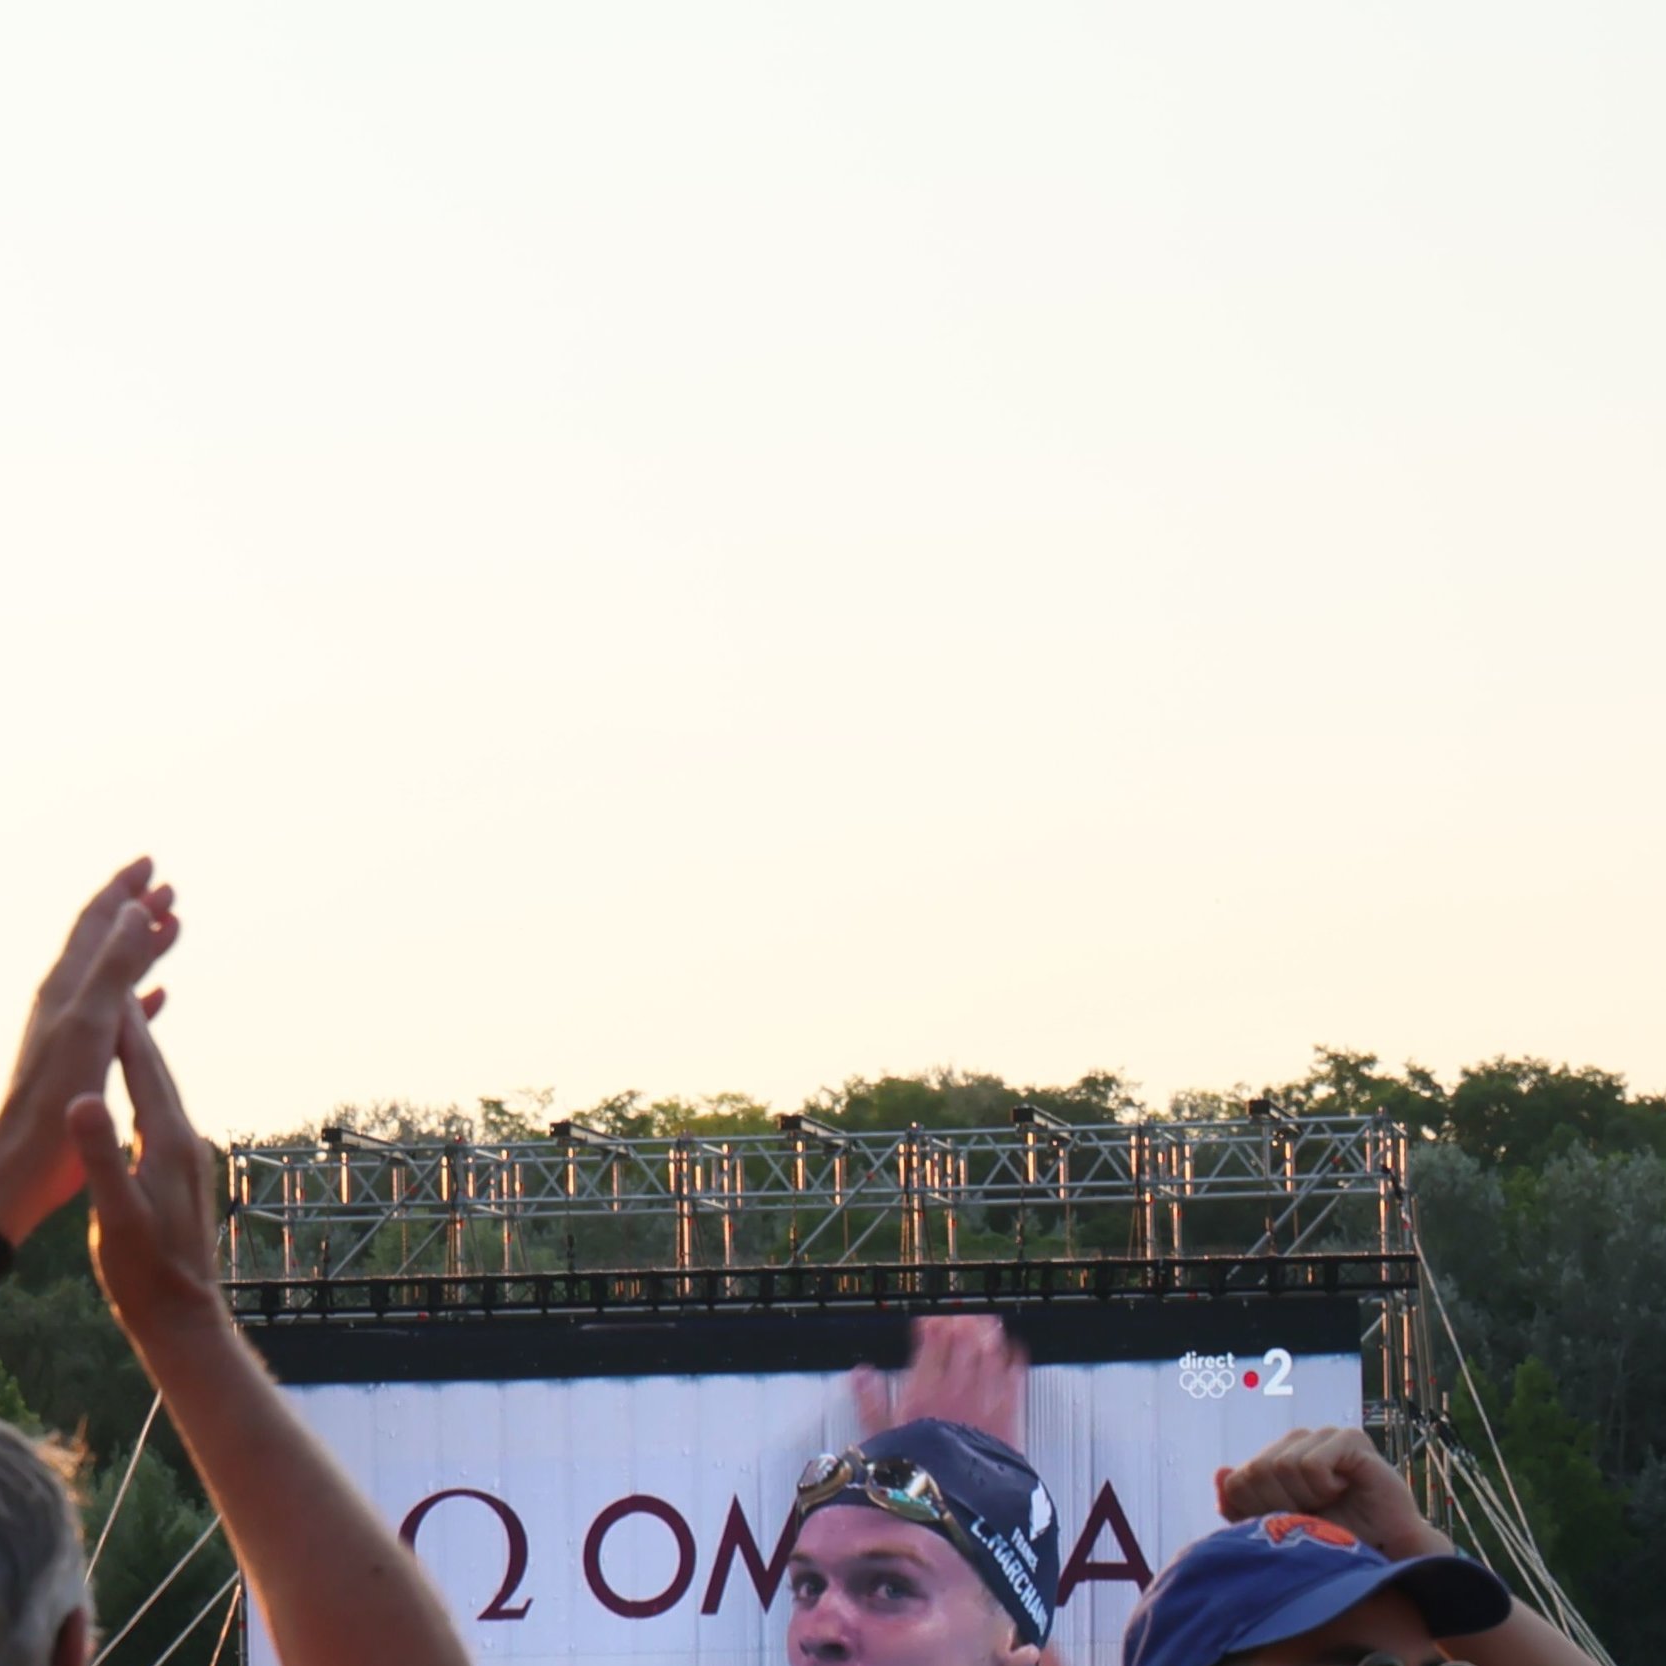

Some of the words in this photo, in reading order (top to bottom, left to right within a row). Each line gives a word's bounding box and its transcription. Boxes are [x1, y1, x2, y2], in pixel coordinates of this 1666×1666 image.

[1179, 1351, 1236, 1369] direct
[1263, 1347, 1294, 1396] 2
[583, 1479, 1155, 1620] OMA
